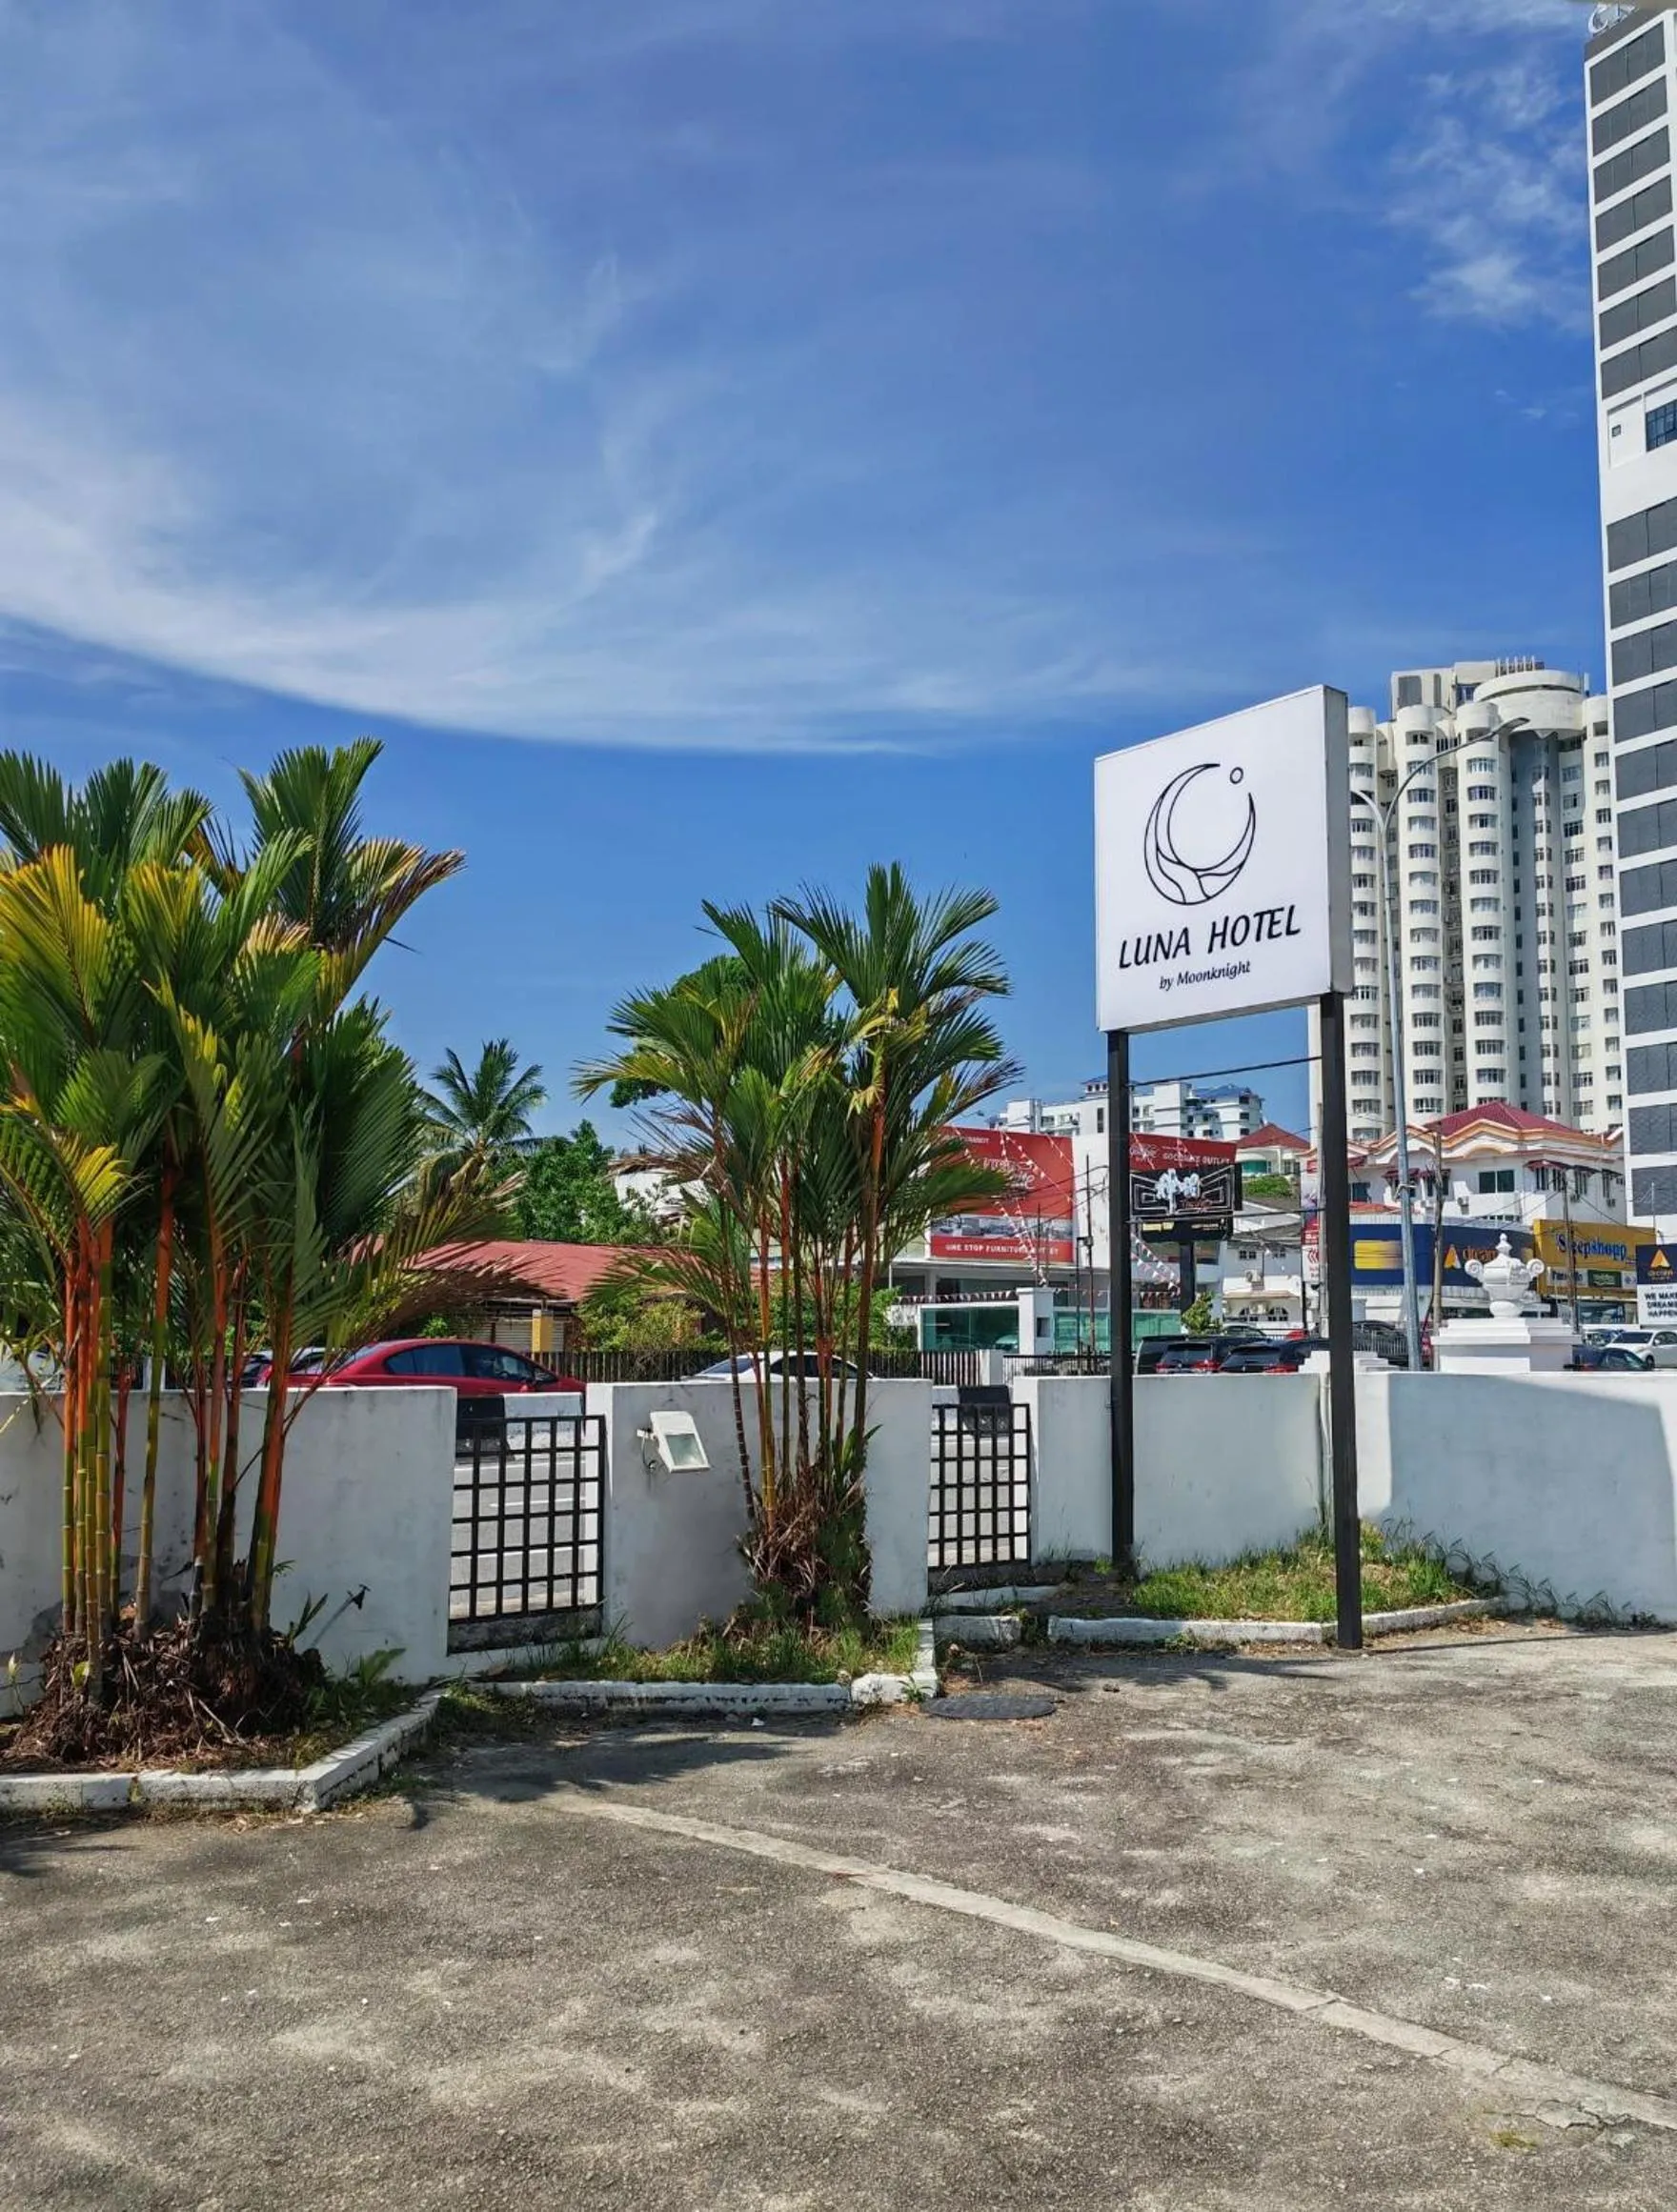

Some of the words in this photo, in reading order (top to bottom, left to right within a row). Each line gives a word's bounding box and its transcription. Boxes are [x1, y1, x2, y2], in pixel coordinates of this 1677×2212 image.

[1119, 926, 1191, 970] LUNA
[1207, 904, 1301, 955] HOTEL
[1159, 975, 1174, 991] by
[1177, 960, 1251, 987] Moonknight
[964, 1243, 983, 1252] STOP
[1555, 1233, 1627, 1261] Seepshopp
[1645, 1292, 1656, 1300] WE
